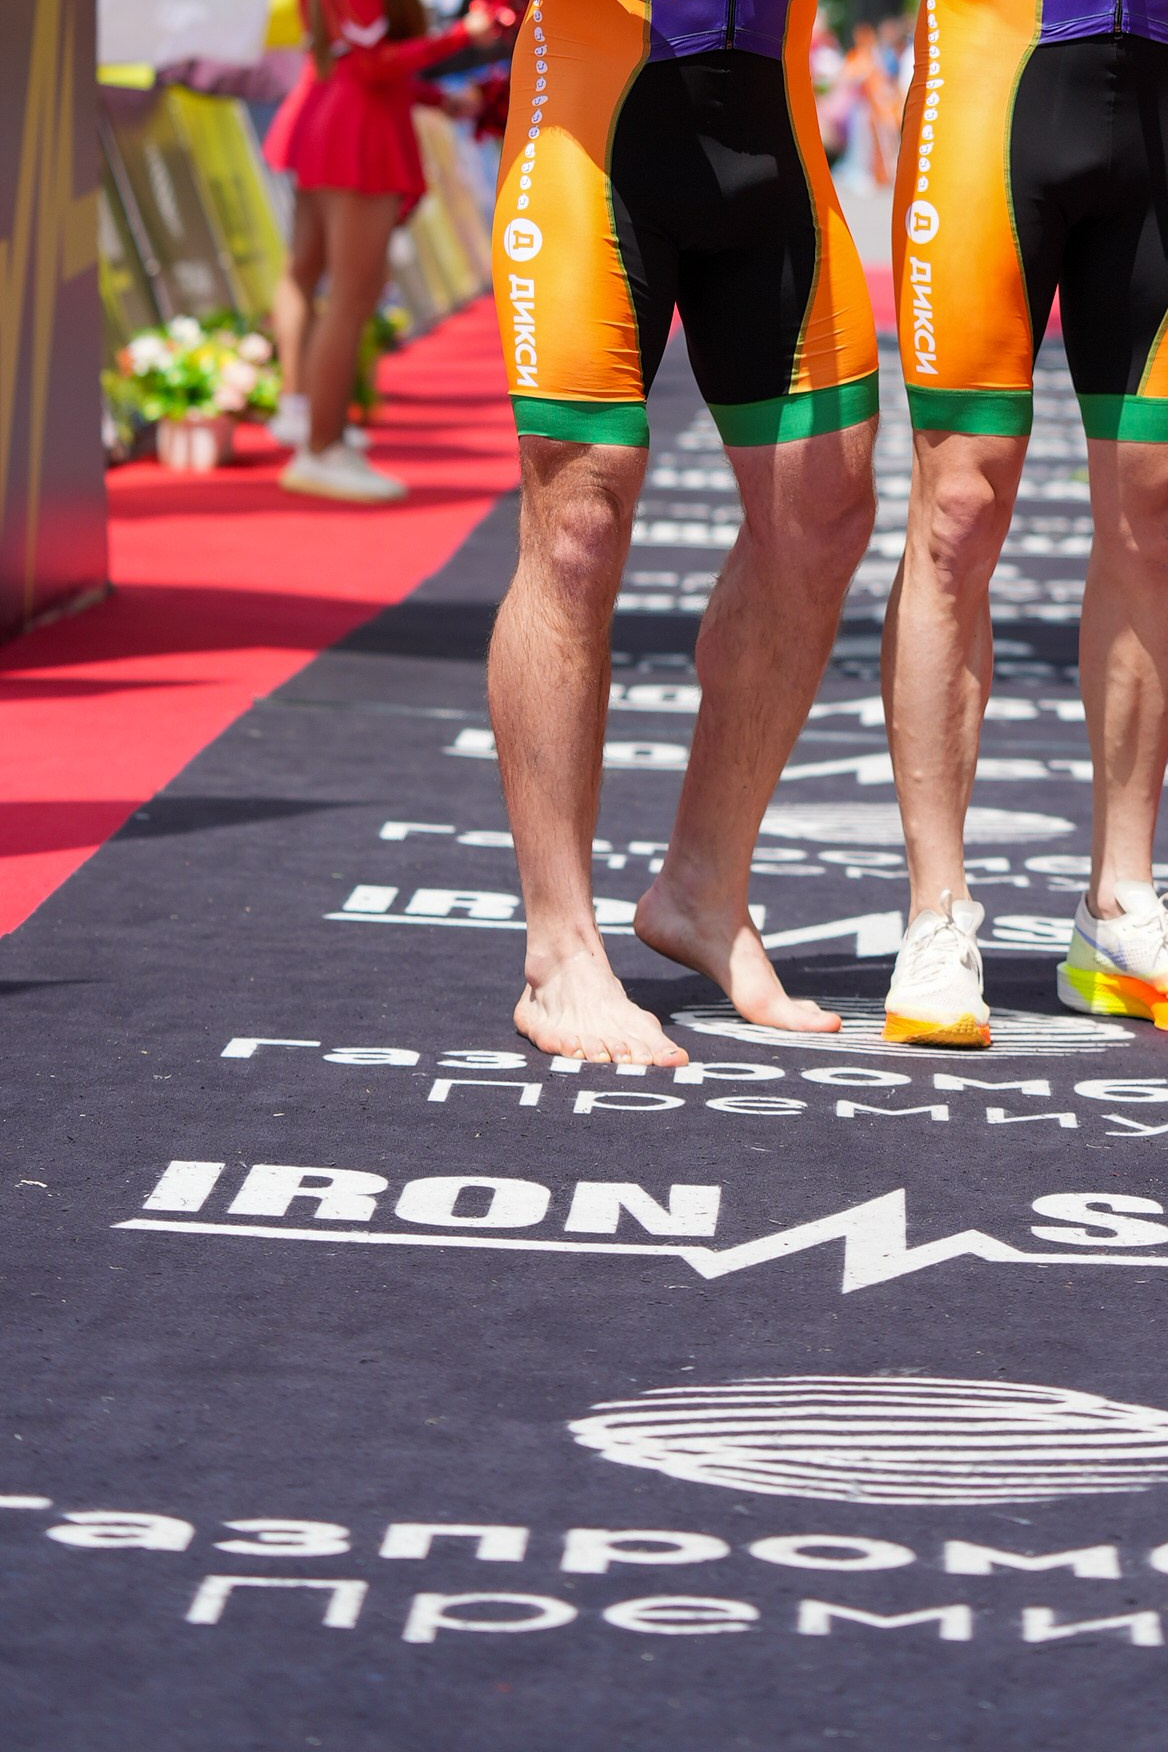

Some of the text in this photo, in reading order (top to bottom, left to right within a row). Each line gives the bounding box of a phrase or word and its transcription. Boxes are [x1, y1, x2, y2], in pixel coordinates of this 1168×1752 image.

[509, 274, 538, 387] ДИКСИ
[910, 257, 937, 375] ДИКСИ
[142, 1159, 722, 1237] IRON
